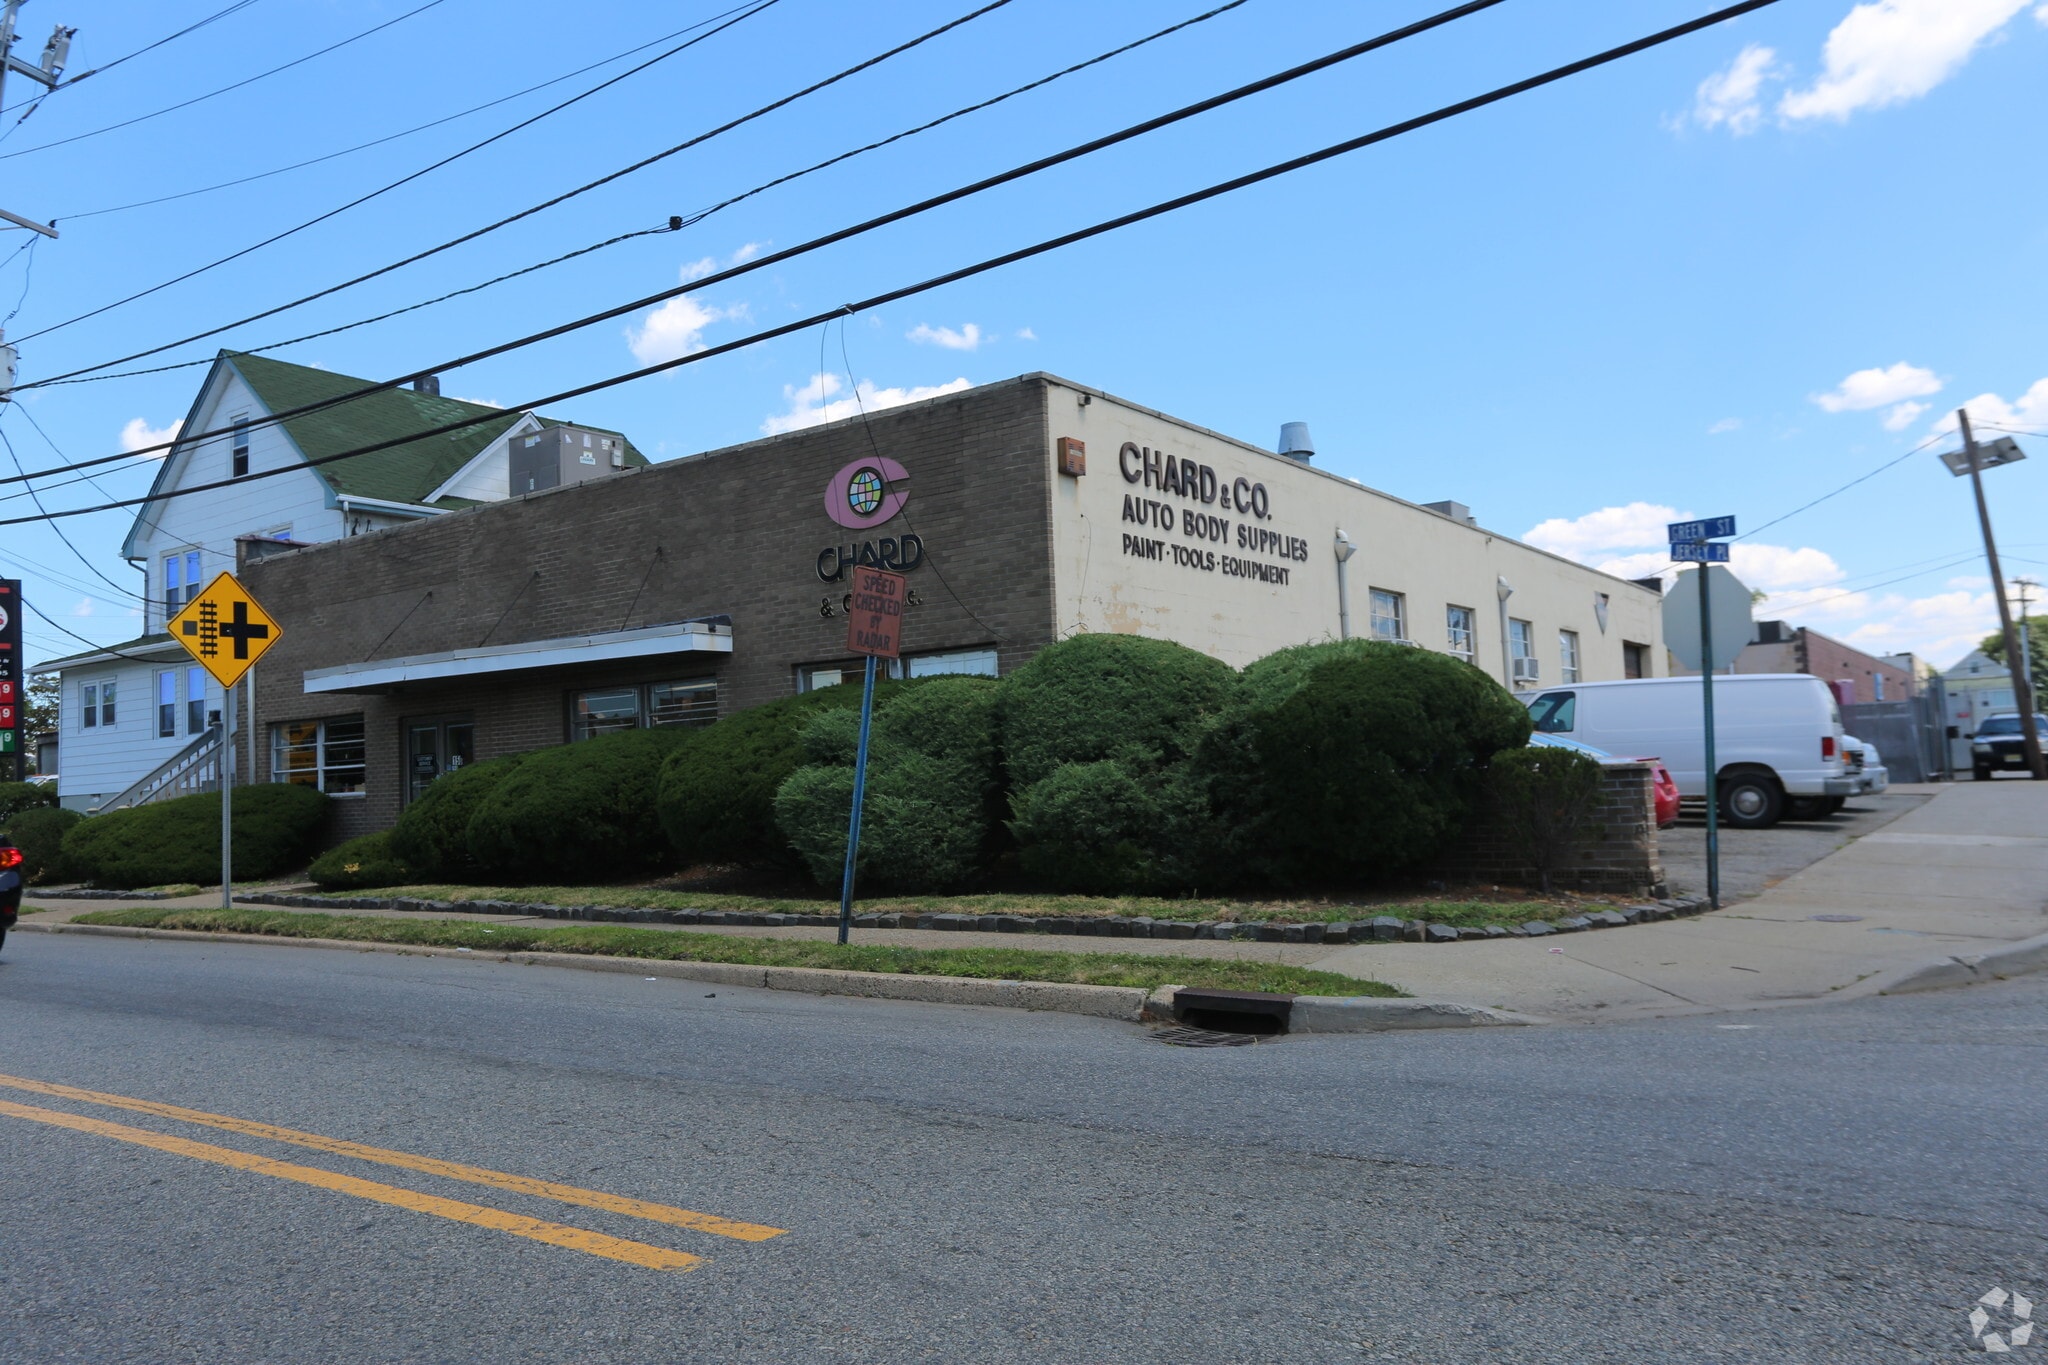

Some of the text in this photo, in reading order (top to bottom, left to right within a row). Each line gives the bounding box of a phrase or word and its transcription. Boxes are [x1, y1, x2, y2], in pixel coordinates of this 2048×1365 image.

[1119, 441, 1273, 521] CHARD & CO.
[1122, 494, 1308, 562] AUTO BODY SUPPLIES
[1716, 518, 1731, 535] ST
[816, 534, 924, 583] CHARD
[1222, 555, 1290, 586] EQUIPMENT
[863, 575, 896, 596] SPEED
[855, 592, 900, 617] CHECKED
[870, 615, 882, 629] BY
[856, 630, 891, 651] RADAR
